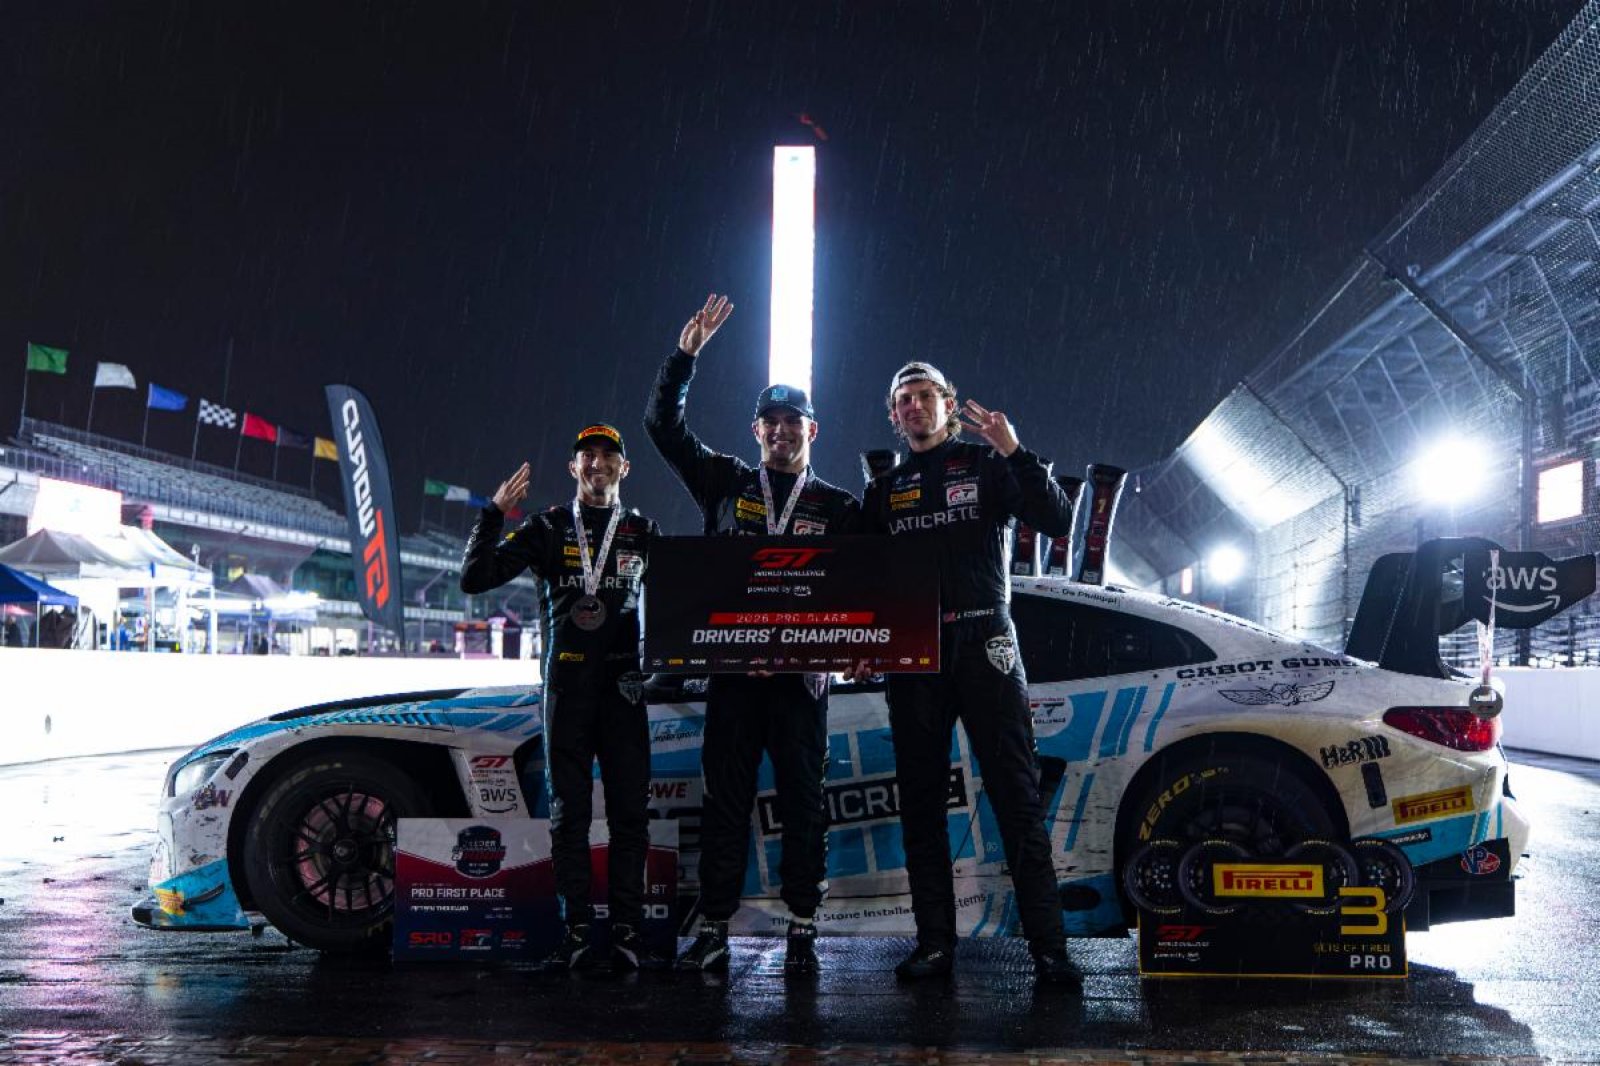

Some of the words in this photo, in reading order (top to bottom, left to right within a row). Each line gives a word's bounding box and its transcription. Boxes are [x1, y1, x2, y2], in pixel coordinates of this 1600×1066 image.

[888, 505, 979, 536] LATICRETE
[692, 627, 776, 644] DRIVERS'
[780, 628, 891, 644] CHAMPIONS
[1176, 660, 1273, 680] CABOT
[1139, 773, 1191, 842] ZERO
[1399, 790, 1466, 820] PIRELLI
[1222, 871, 1313, 891] PIRELLI
[411, 887, 434, 899] PRO
[436, 887, 467, 899] FIRST
[470, 887, 505, 899] PLACE
[823, 911, 861, 922] Stone
[1338, 886, 1389, 936] 3
[1349, 954, 1392, 969] PRO
